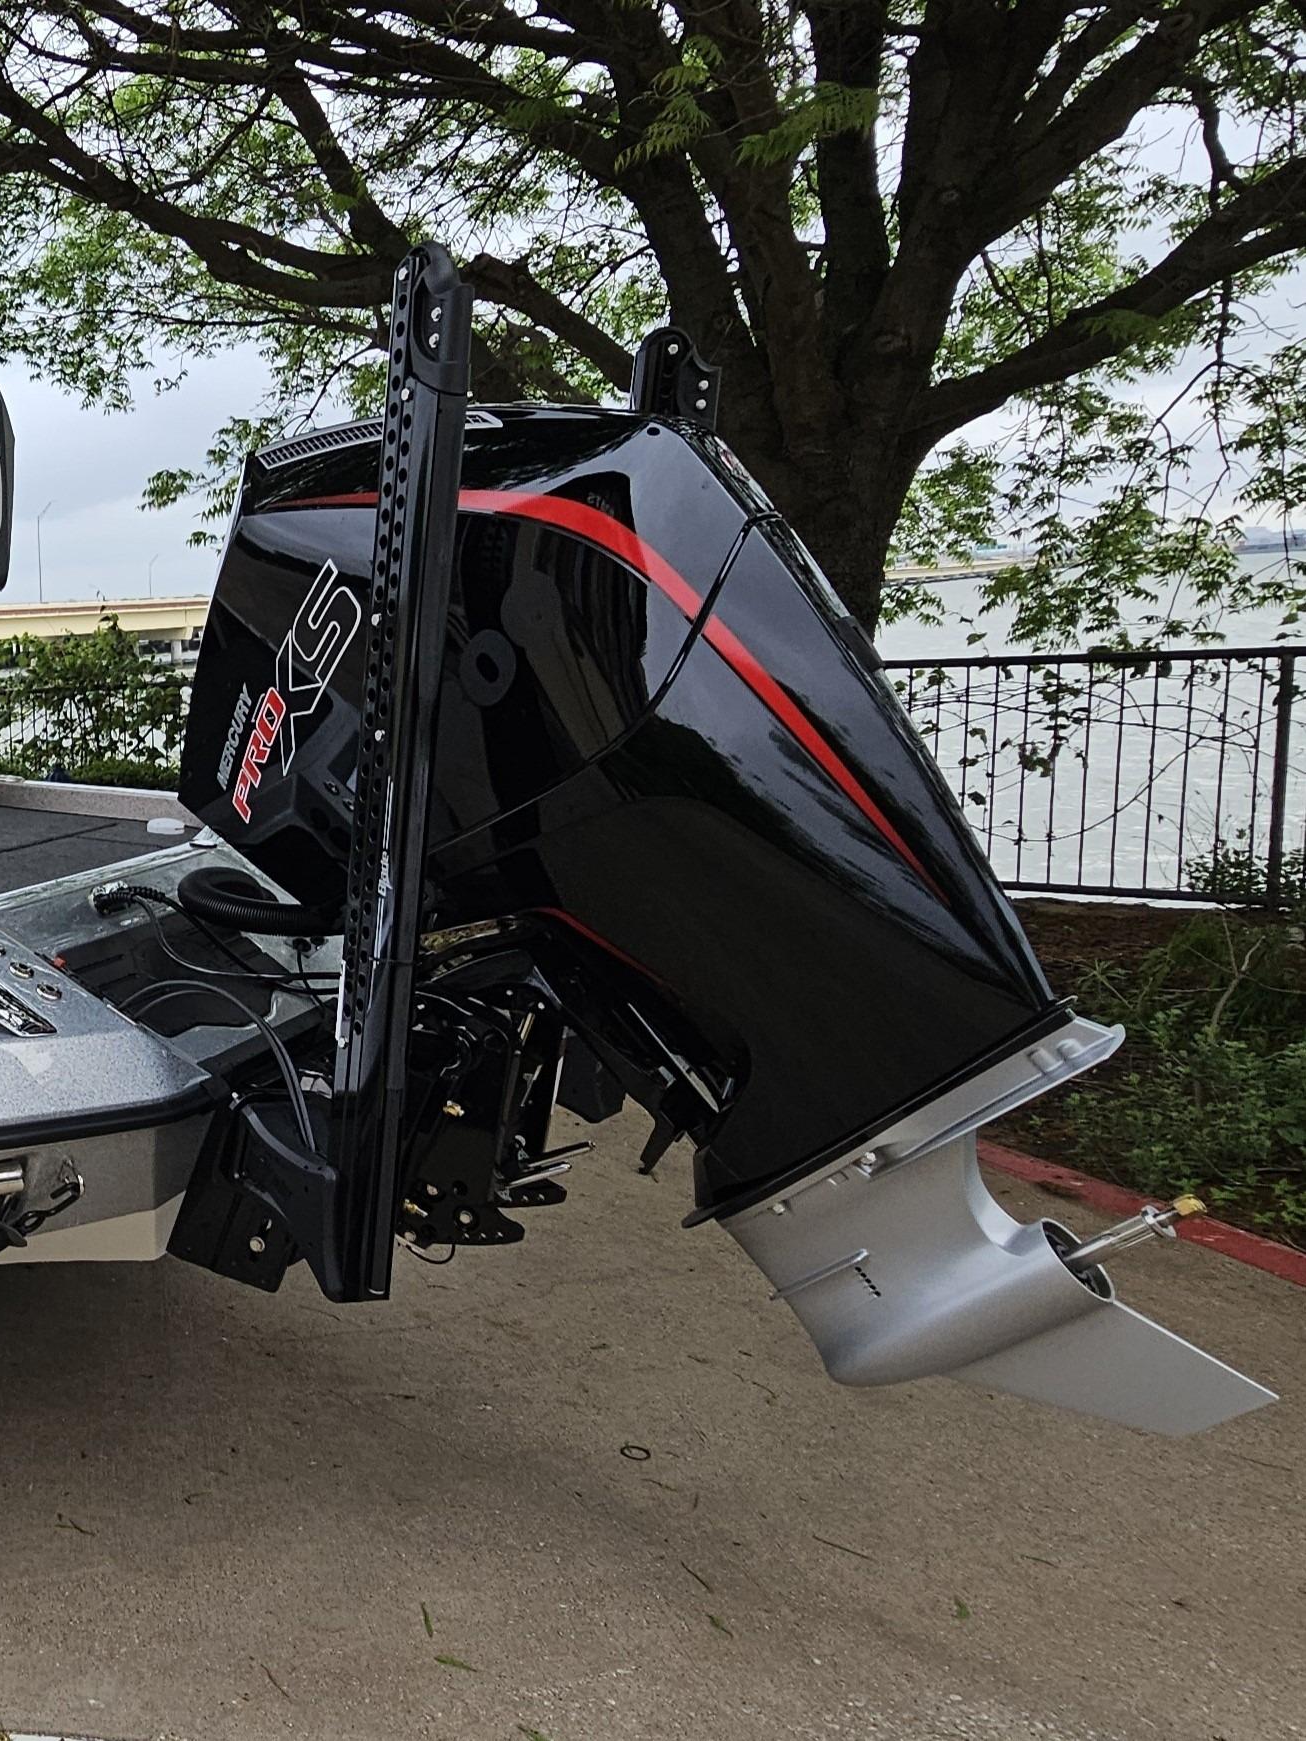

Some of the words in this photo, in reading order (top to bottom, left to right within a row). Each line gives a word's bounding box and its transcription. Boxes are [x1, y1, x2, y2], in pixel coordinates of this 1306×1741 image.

[252, 559, 362, 776] XS
[217, 682, 252, 791] MERCURY
[232, 687, 286, 824] PRO
[378, 850, 392, 897] Blade
